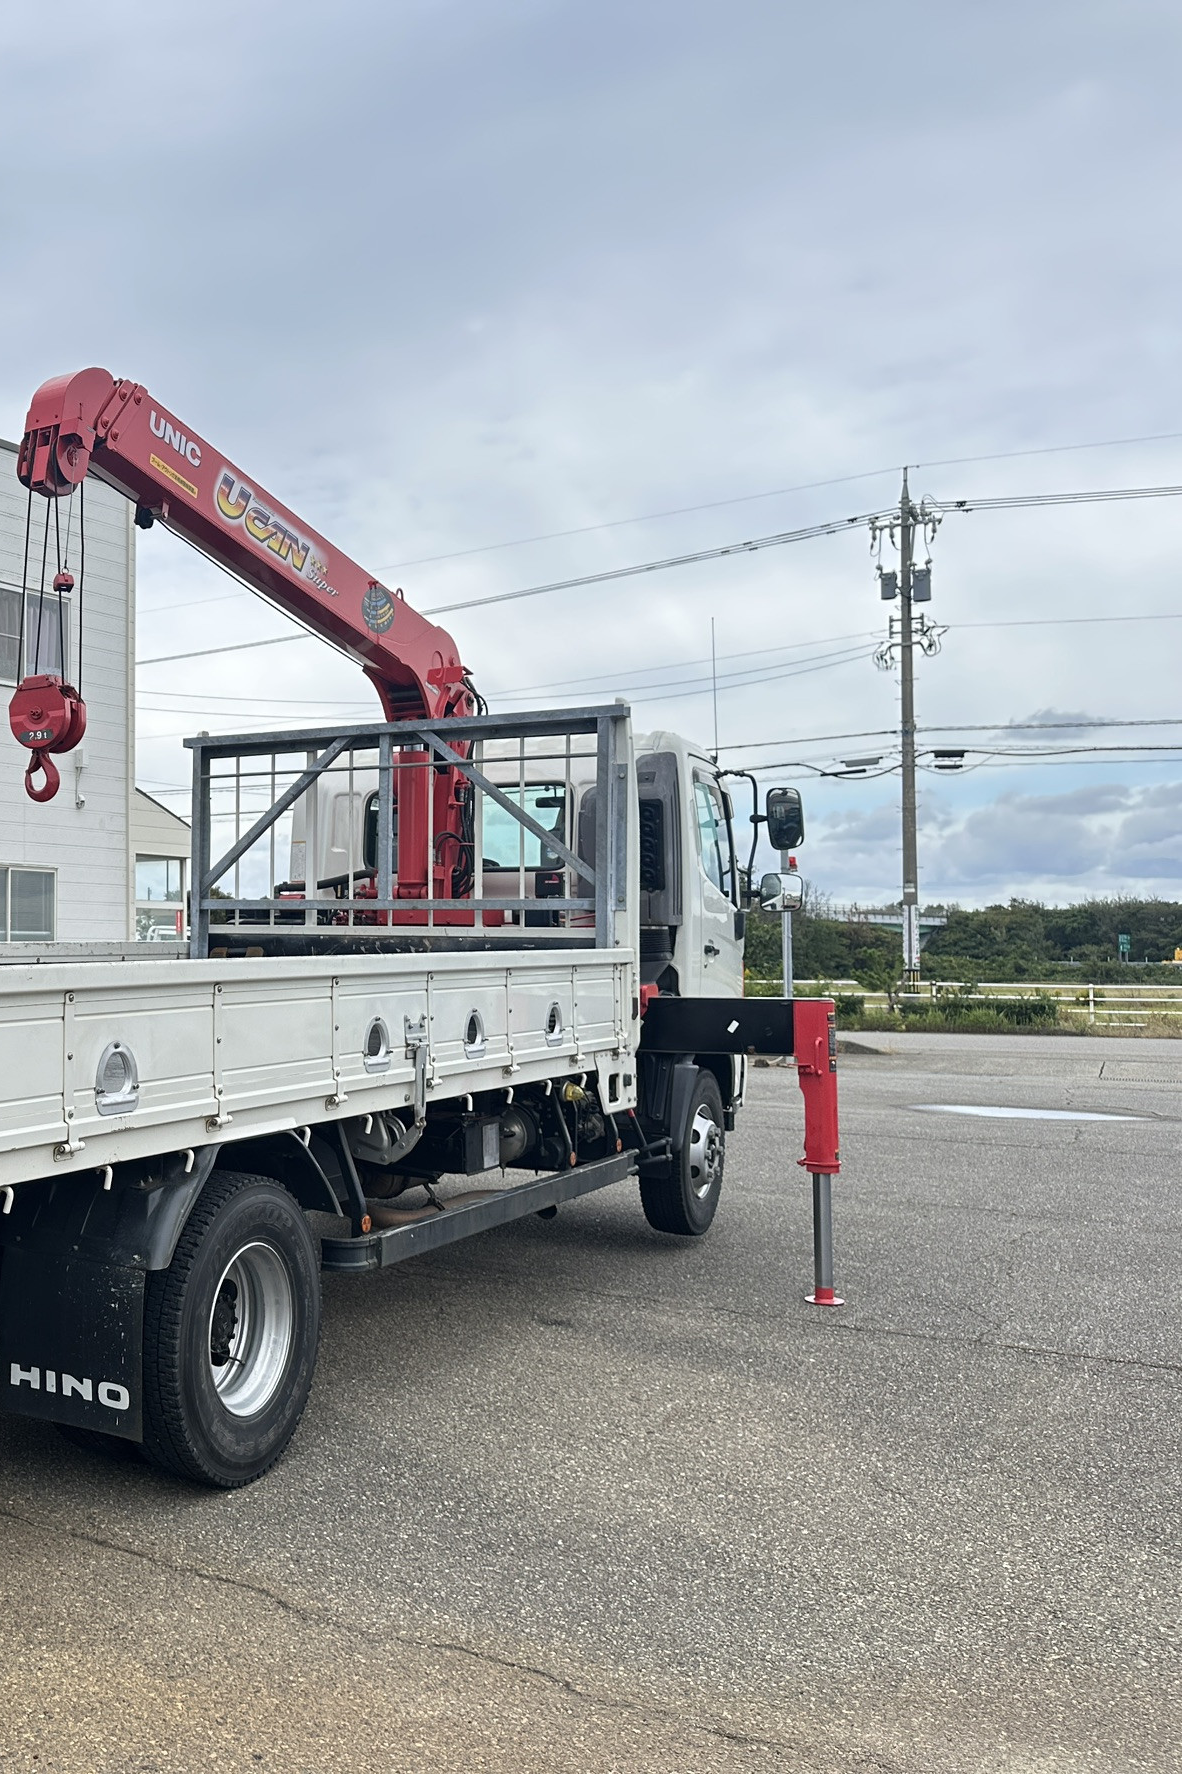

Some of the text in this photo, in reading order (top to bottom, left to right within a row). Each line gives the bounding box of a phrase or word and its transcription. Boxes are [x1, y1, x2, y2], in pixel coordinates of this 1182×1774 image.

[149, 409, 202, 467] UNIC
[306, 569, 339, 597] Super
[10, 1362, 130, 1411] HINO
